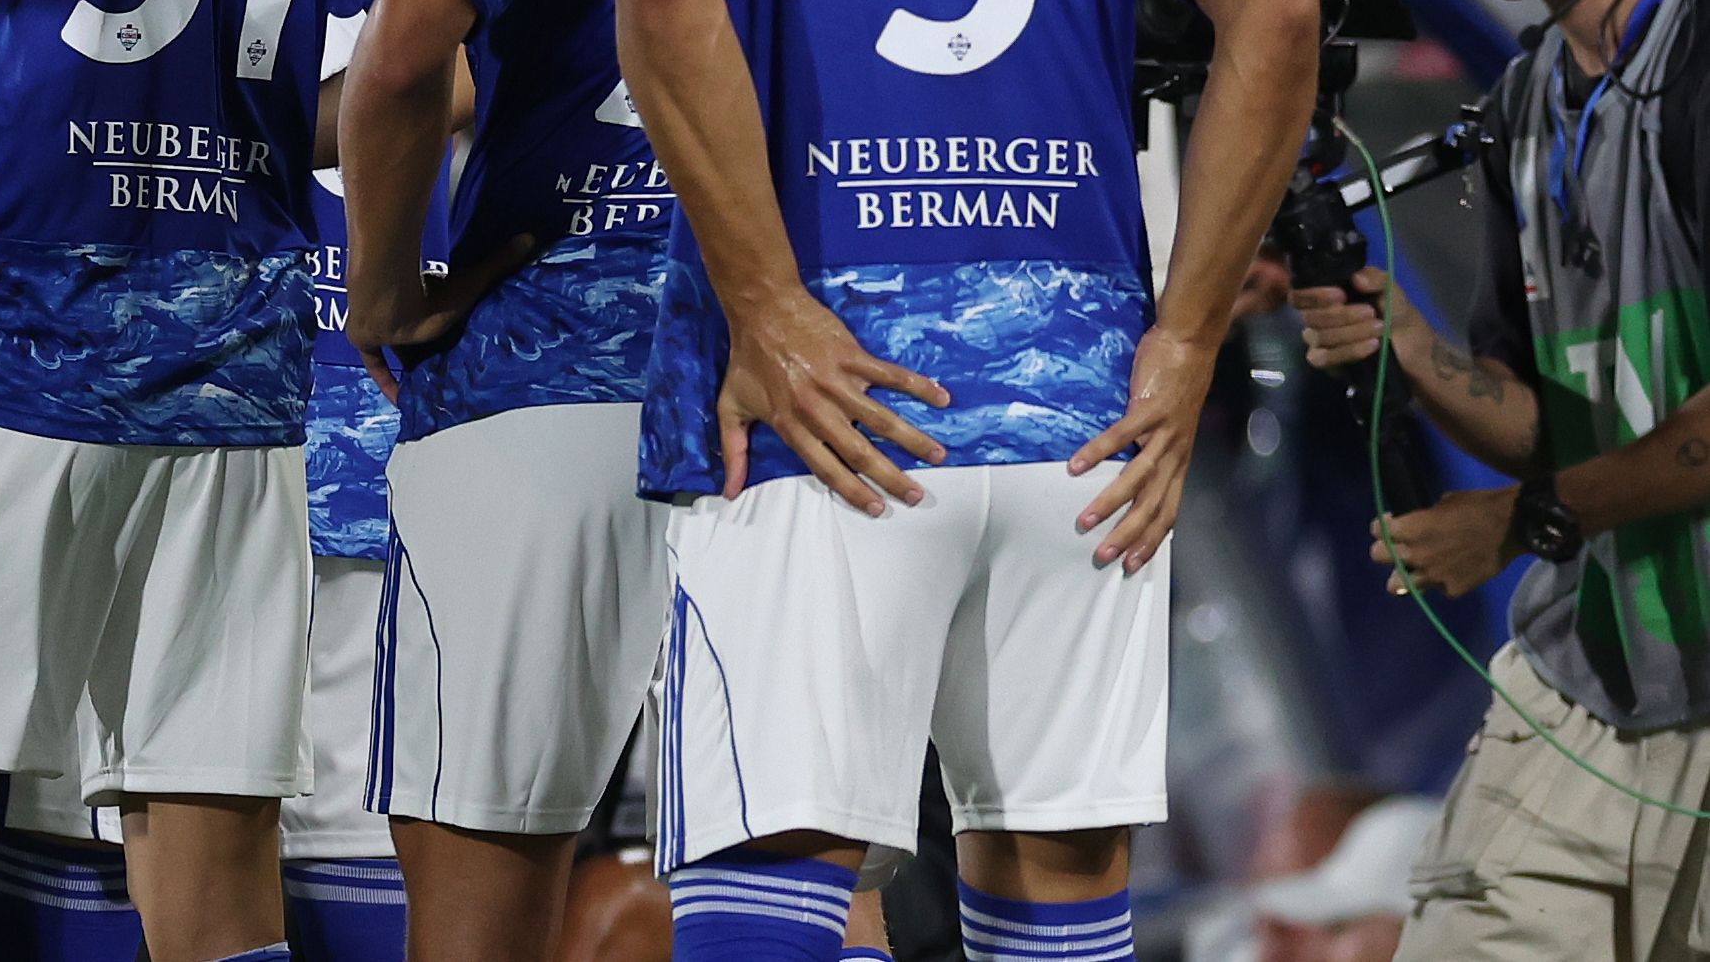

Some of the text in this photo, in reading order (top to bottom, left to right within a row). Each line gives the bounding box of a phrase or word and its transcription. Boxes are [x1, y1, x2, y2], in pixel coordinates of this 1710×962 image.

[66, 120, 274, 177] NEUBEGER
[805, 136, 1100, 177] NEUBERGER
[108, 172, 239, 223] BERMN
[855, 189, 1061, 230] BERMAN
